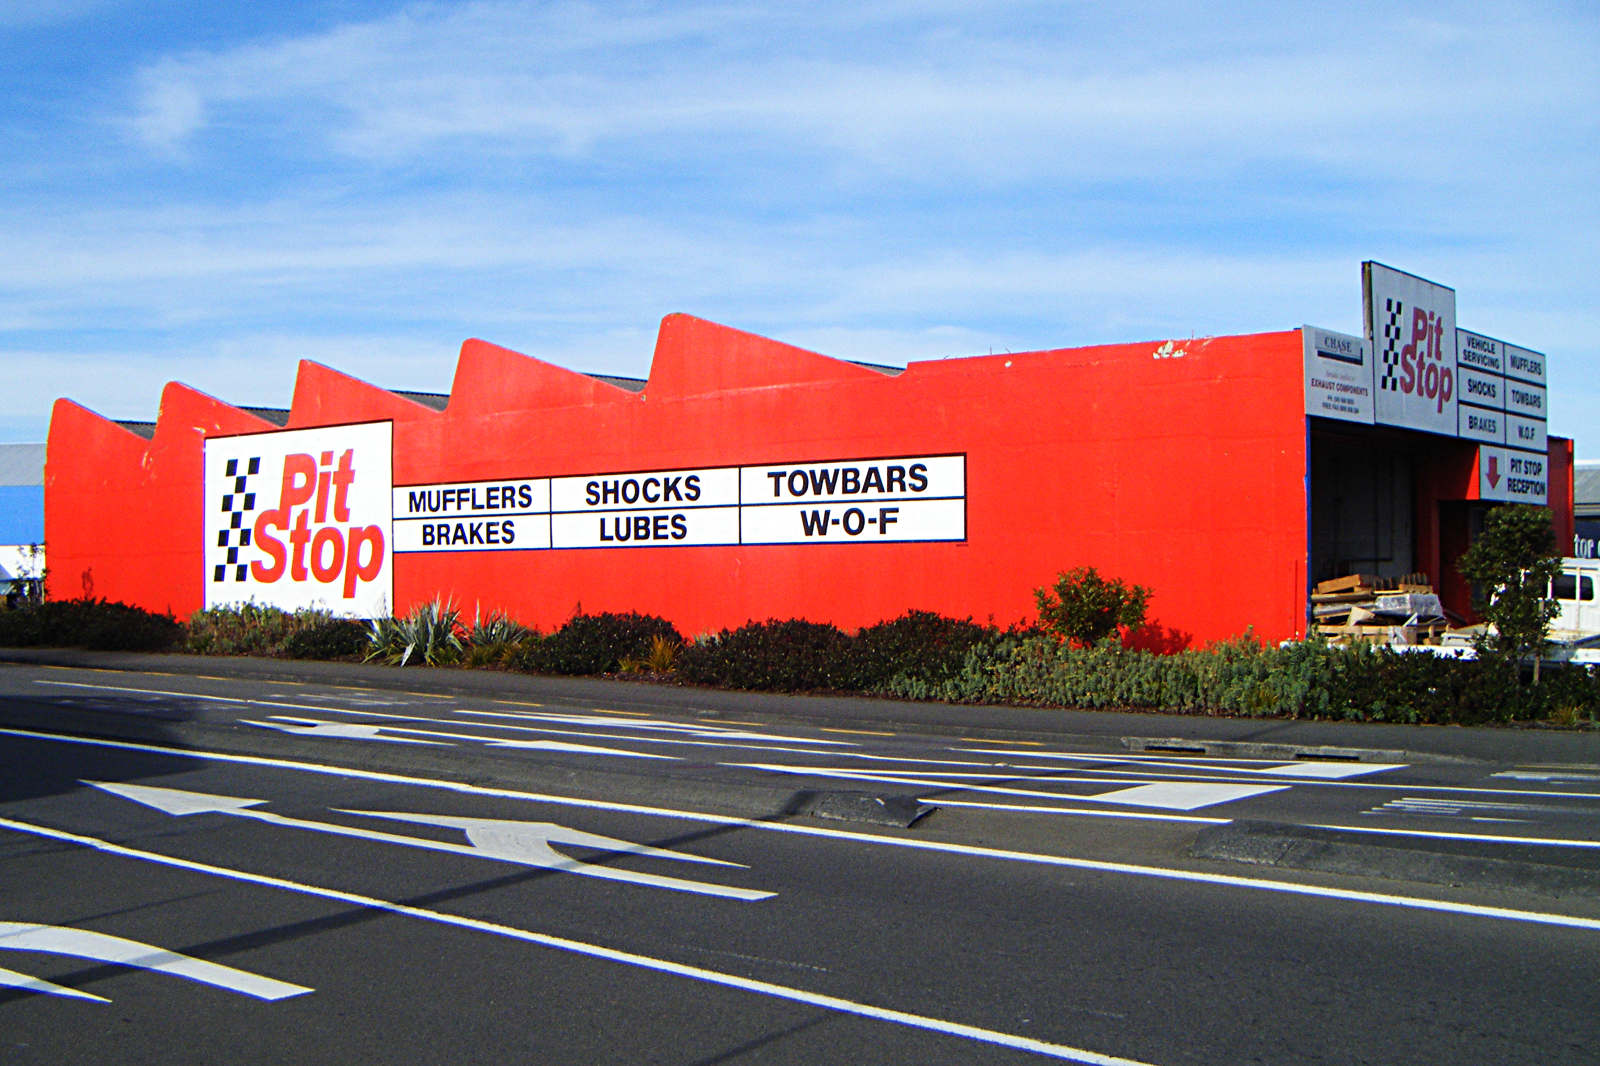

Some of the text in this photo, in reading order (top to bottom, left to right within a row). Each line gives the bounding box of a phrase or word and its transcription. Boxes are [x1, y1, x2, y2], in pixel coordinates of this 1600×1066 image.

[1412, 307, 1443, 360] Pit
[1467, 336, 1495, 354] VEHICLE
[1463, 349, 1499, 370] SERVICING
[1510, 355, 1542, 376] MUFFLERS
[1400, 344, 1453, 414] Stop
[1468, 378, 1496, 399] SHOCKS
[1512, 389, 1541, 409] TOWBARS
[1468, 415, 1496, 434] BRAKES
[767, 463, 928, 497] TOWBARS
[1511, 458, 1542, 475] PIT STOP
[280, 449, 355, 530] Pit
[408, 485, 532, 513] MUFFLERS
[586, 475, 701, 505] SHOCKS
[1507, 477, 1545, 495] RECEPTION
[422, 520, 515, 546] BRAKES
[600, 514, 687, 542] LUBES
[800, 507, 900, 537] W-O-F
[251, 509, 385, 598] Stop
